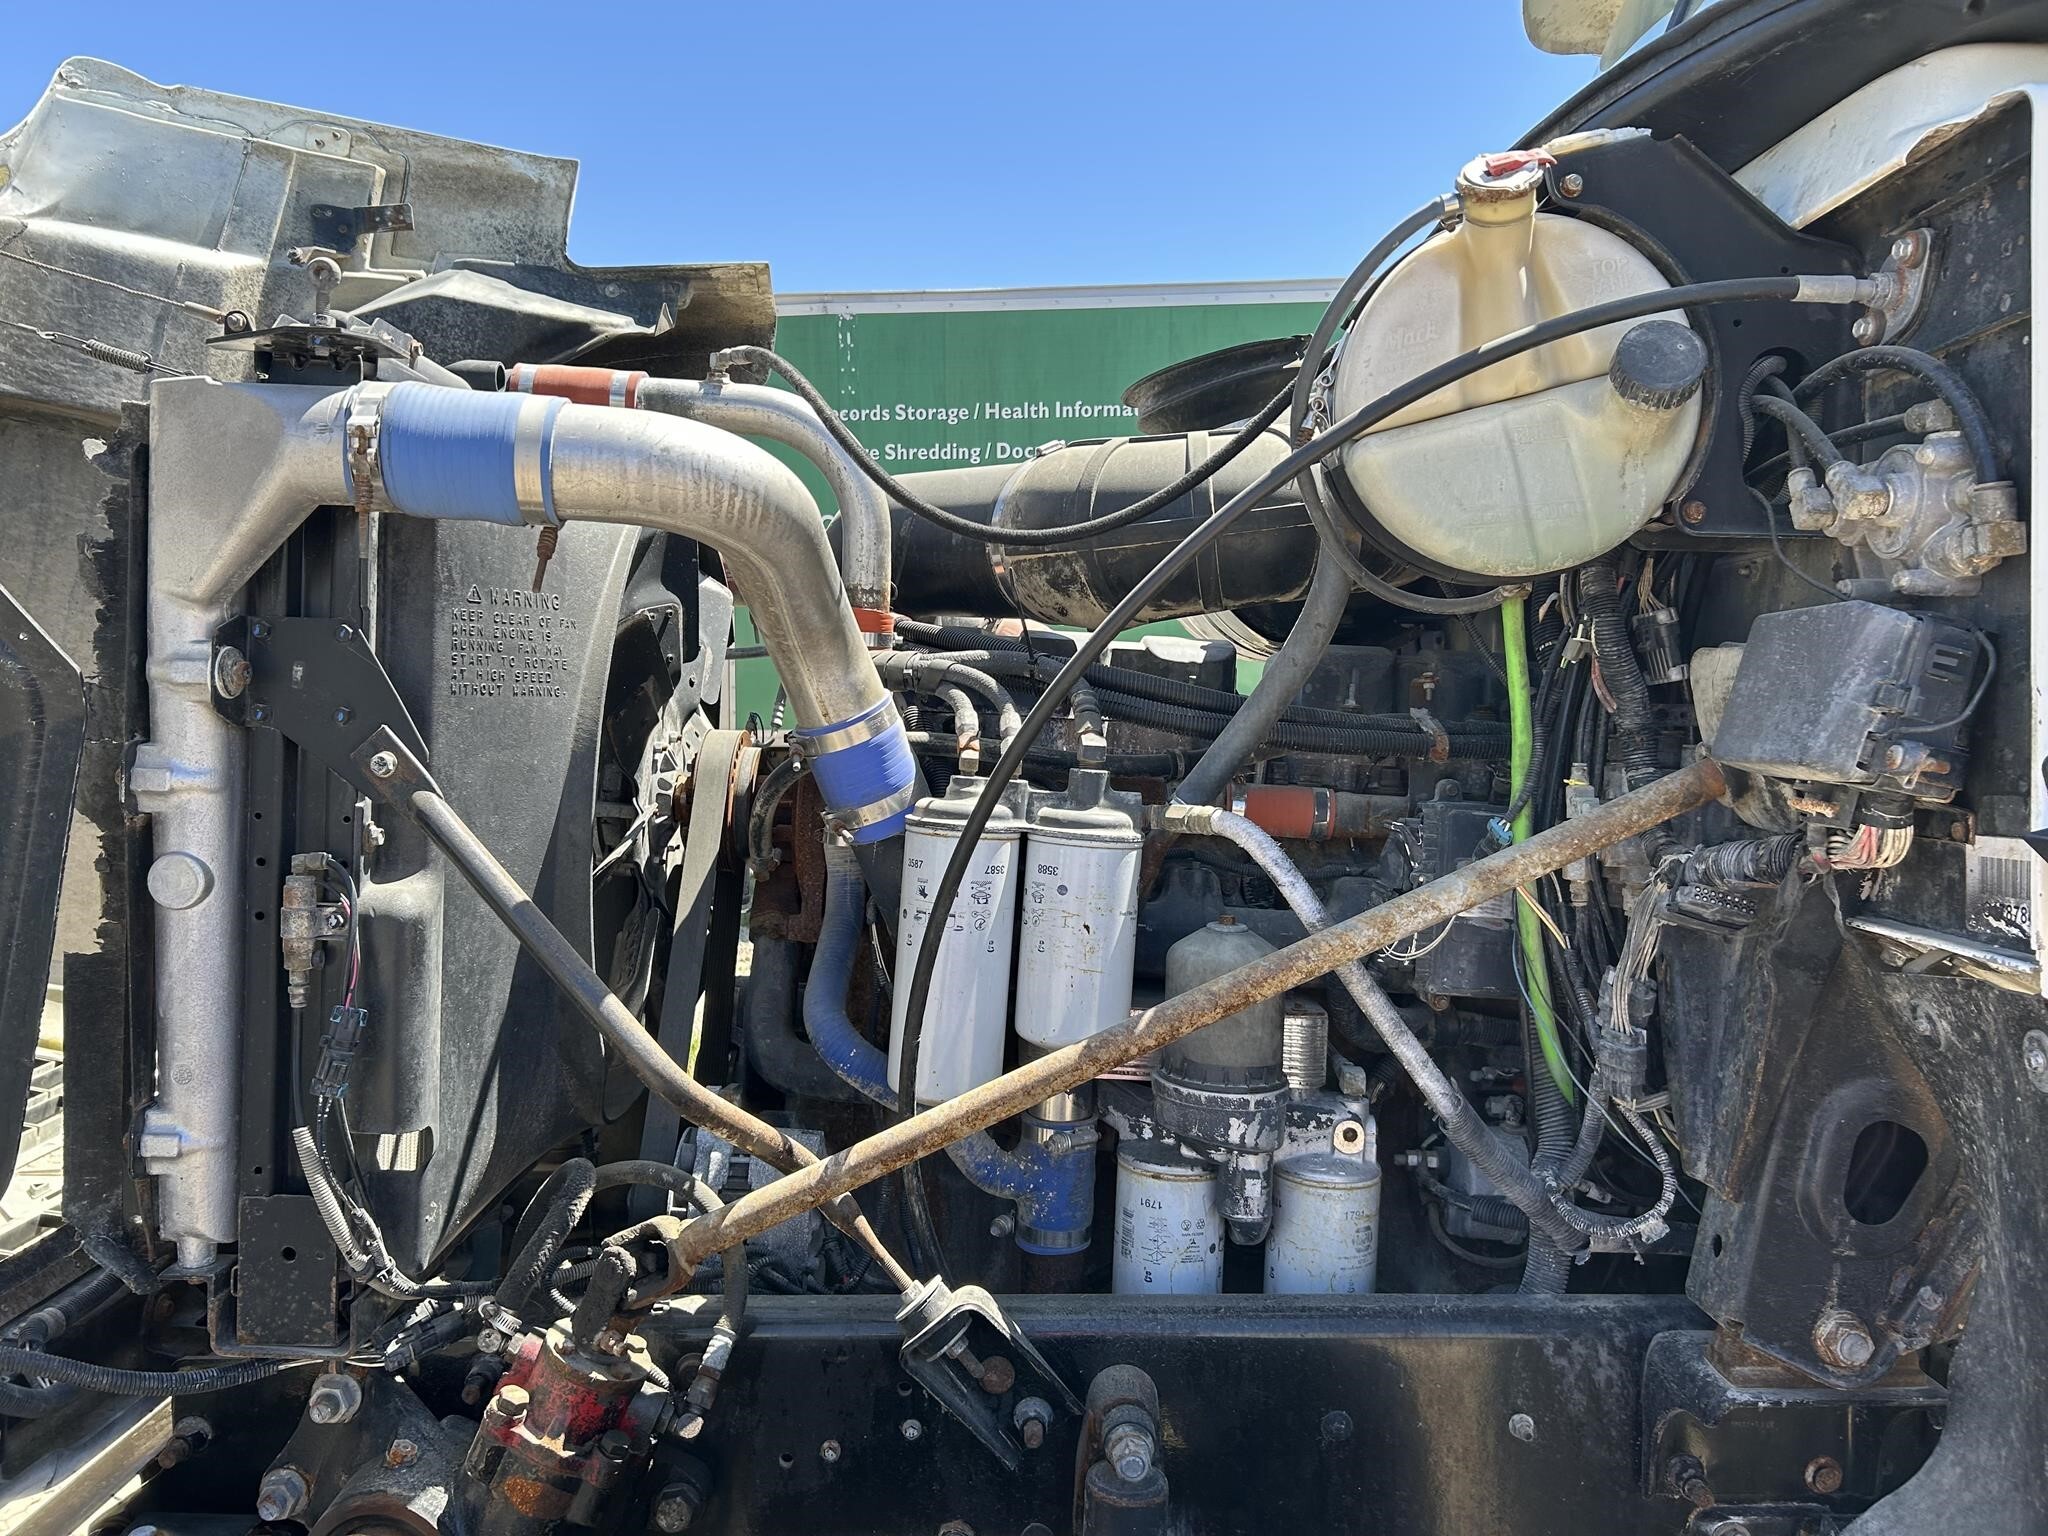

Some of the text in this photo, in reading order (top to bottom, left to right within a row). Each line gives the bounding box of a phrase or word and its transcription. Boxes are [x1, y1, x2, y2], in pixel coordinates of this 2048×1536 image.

[895, 403, 970, 426] Storage
[974, 402, 980, 420] /
[985, 401, 1050, 420] Health
[885, 442, 981, 464] Shredding
[985, 443, 992, 460] /
[489, 587, 560, 611] WARNING
[451, 607, 577, 630] KEEP CLEAR OF FAN
[451, 622, 552, 642] WHEN ENGINE IS
[451, 637, 563, 656] RUNNING FAN MAY
[450, 652, 568, 671] START TO ROTATE
[450, 667, 553, 684] AT HIGH SPEED
[450, 681, 503, 697] WITHOUT
[907, 857, 924, 869] 3587
[984, 864, 1005, 875] 3587
[1037, 863, 1059, 876] 3588
[1140, 1197, 1163, 1210] 1791
